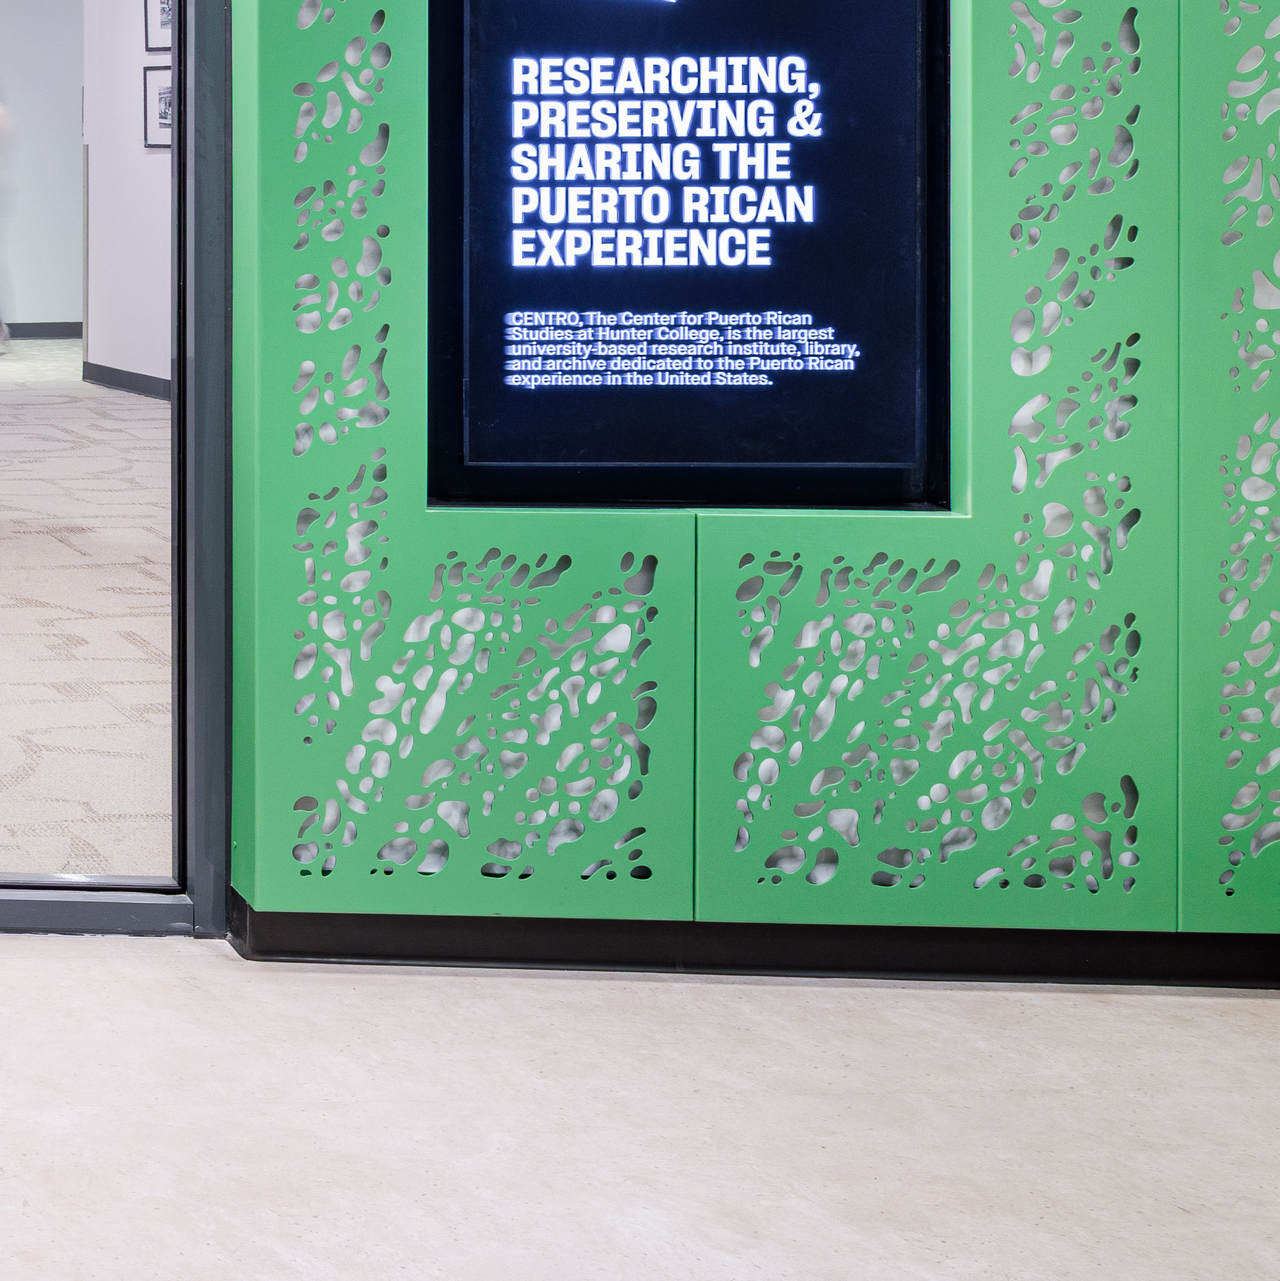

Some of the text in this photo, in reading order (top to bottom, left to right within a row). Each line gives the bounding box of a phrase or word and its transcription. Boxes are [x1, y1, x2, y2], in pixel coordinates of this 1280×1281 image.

[511, 56, 821, 99] RESEARCHING,
[511, 98, 823, 138] PRESERVING &
[510, 142, 792, 181] SHARING THE
[511, 185, 815, 224] PUERTO RICAN
[511, 228, 772, 267] EXPERIENCE
[511, 311, 813, 327] CENTRO, The Center for Puerto Rican
[511, 326, 835, 343] Studies at Hunter College, is the largest
[511, 341, 861, 358] university-based research institute, library,
[511, 356, 855, 370] and archive dedicated to the Puerto Rican
[511, 371, 774, 389] experience in the United States.
